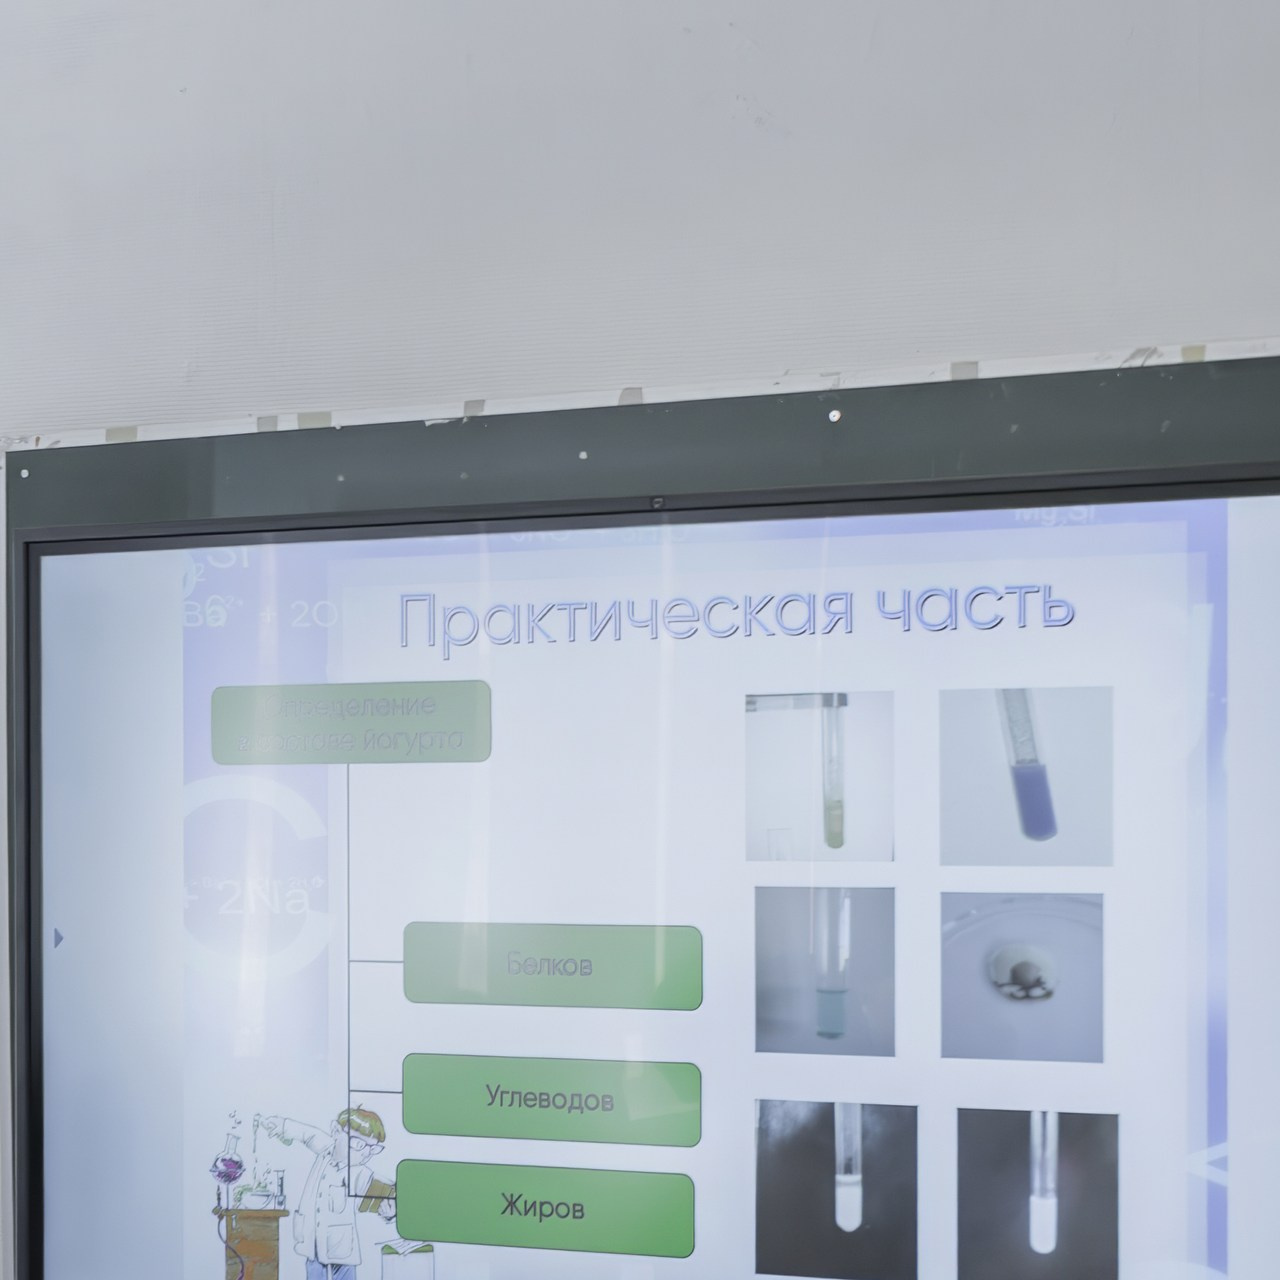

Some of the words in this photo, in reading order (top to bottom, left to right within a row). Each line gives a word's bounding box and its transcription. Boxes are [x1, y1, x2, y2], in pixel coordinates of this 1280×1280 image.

[399, 590, 854, 660] Практическая
[876, 583, 1077, 632] часть
[506, 951, 593, 977] Белков
[485, 1083, 615, 1114] Углеводов
[501, 1192, 585, 1224] Жиров
